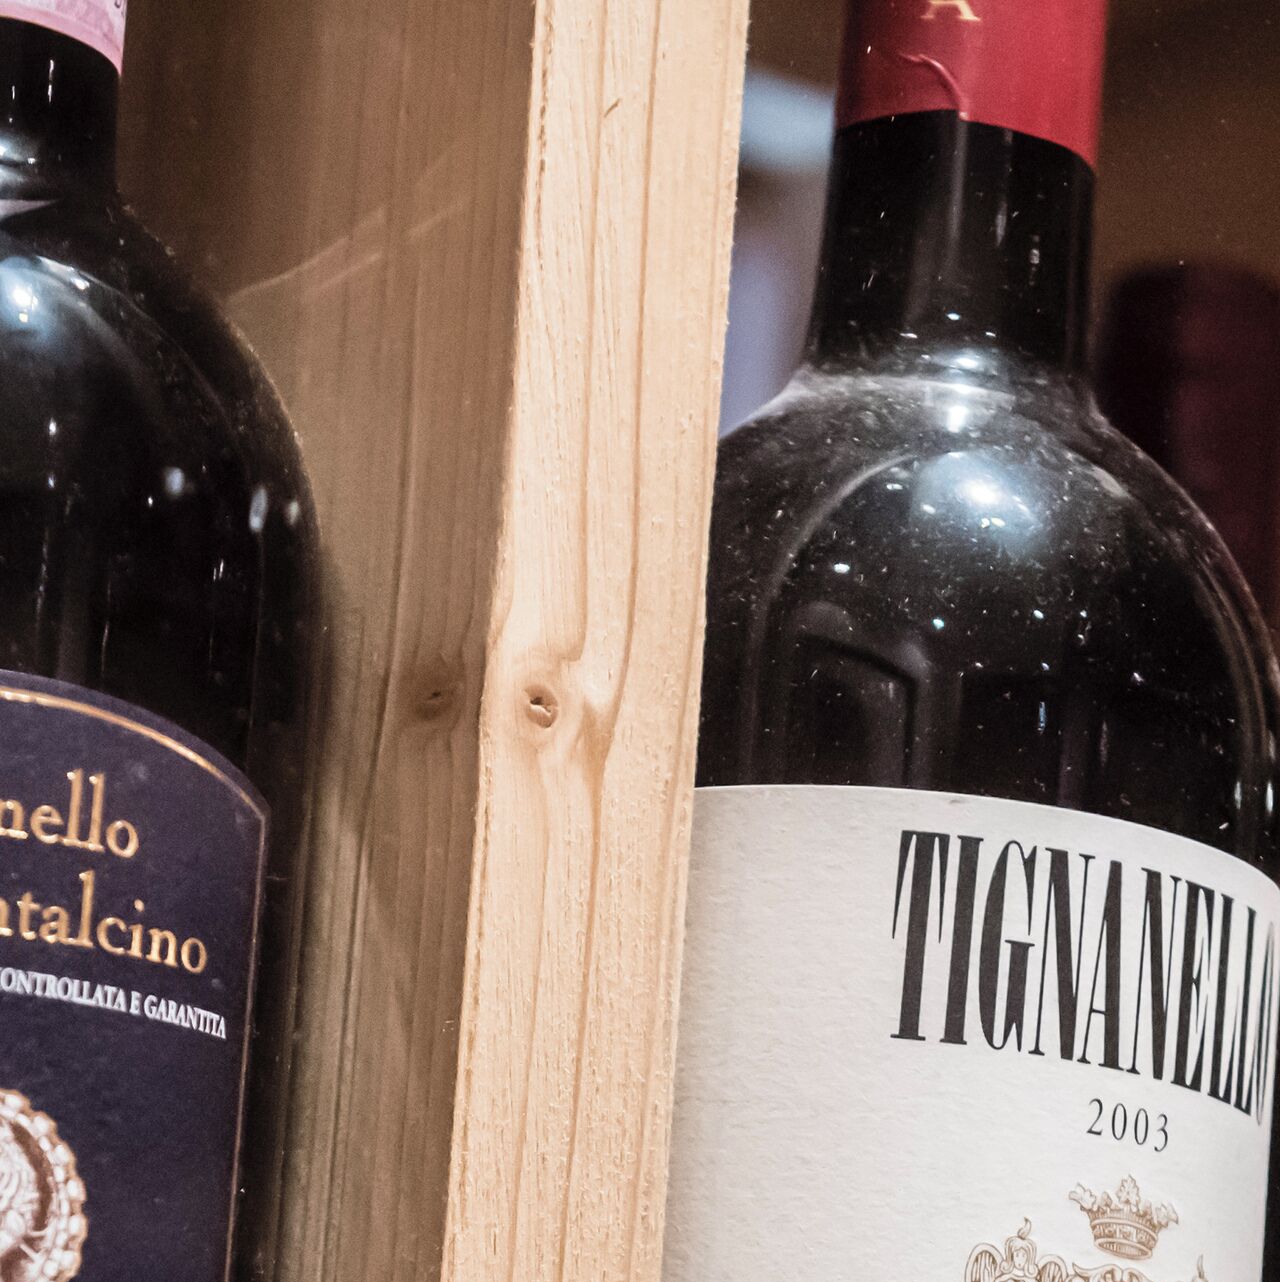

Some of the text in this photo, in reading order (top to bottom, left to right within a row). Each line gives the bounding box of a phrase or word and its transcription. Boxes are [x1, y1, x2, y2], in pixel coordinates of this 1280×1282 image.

[890, 830, 1275, 1126] TIGNANELLO
[129, 992, 141, 1016] E
[143, 995, 227, 1040] GARANTITA
[1086, 1098, 1169, 1152] 2003
